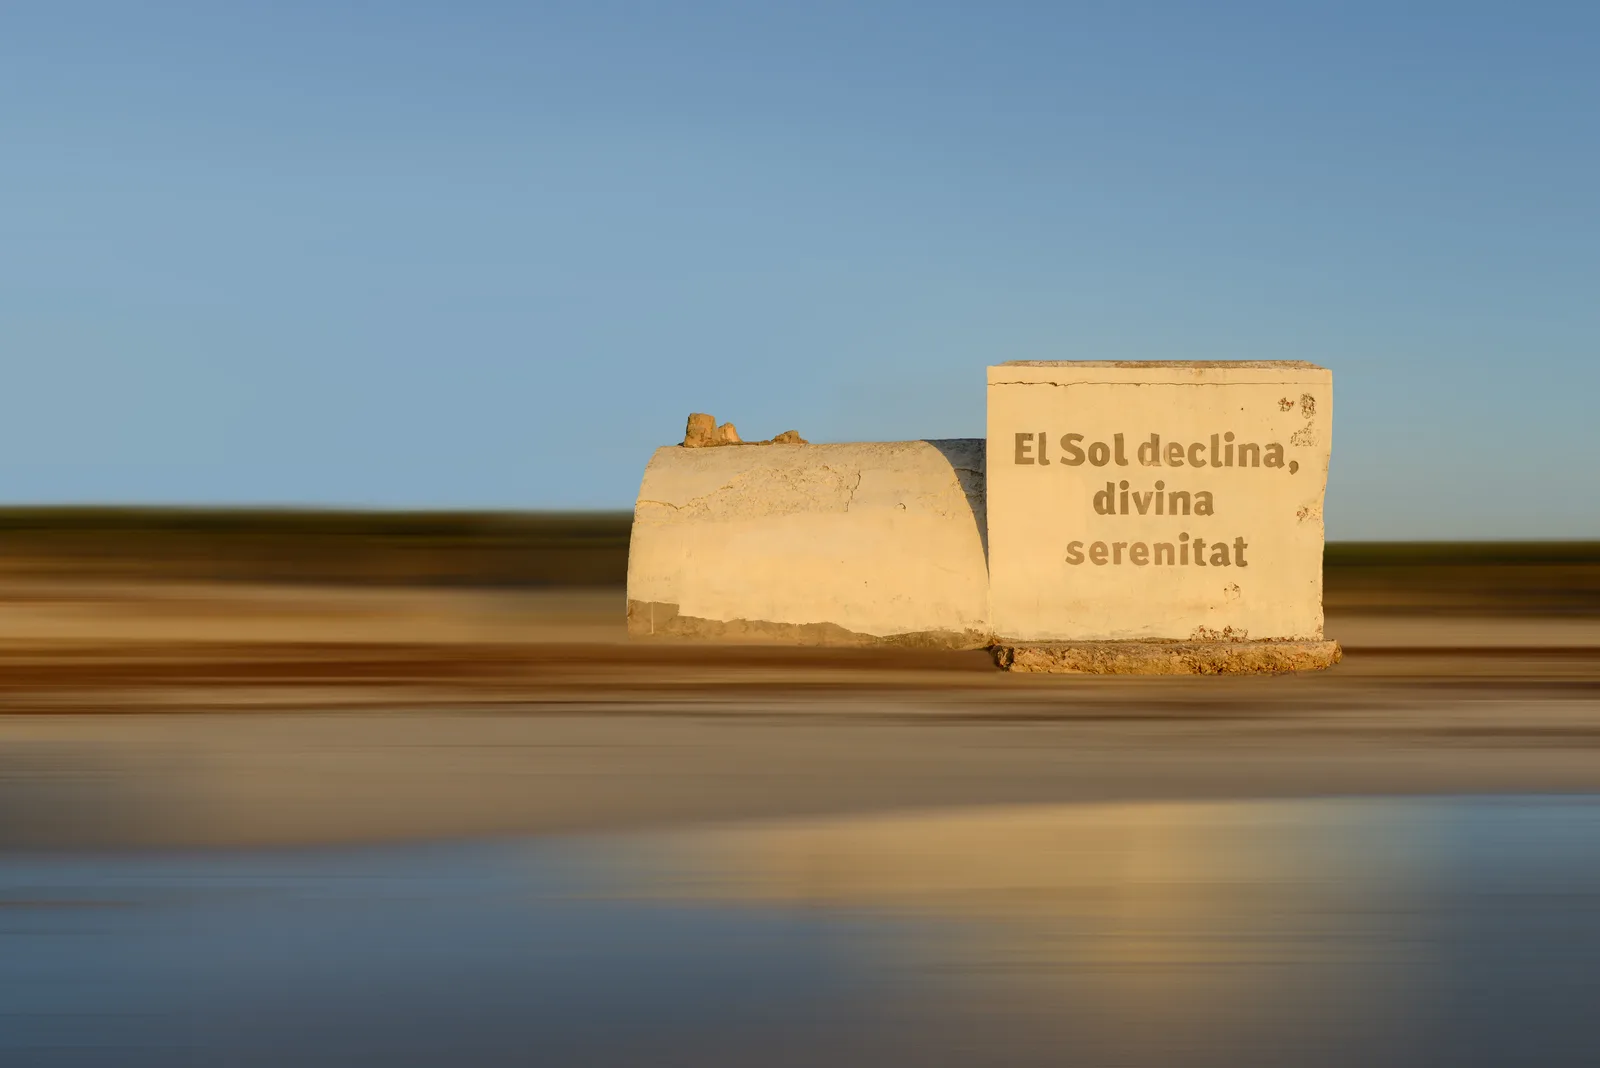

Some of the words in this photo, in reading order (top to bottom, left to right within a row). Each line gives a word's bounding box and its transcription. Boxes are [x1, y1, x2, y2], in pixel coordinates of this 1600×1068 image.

[1015, 432, 1050, 466] El
[1060, 432, 1128, 467] Sol
[1138, 431, 1299, 475] declina,
[1093, 480, 1214, 516] divina
[1065, 532, 1248, 567] serenitat
